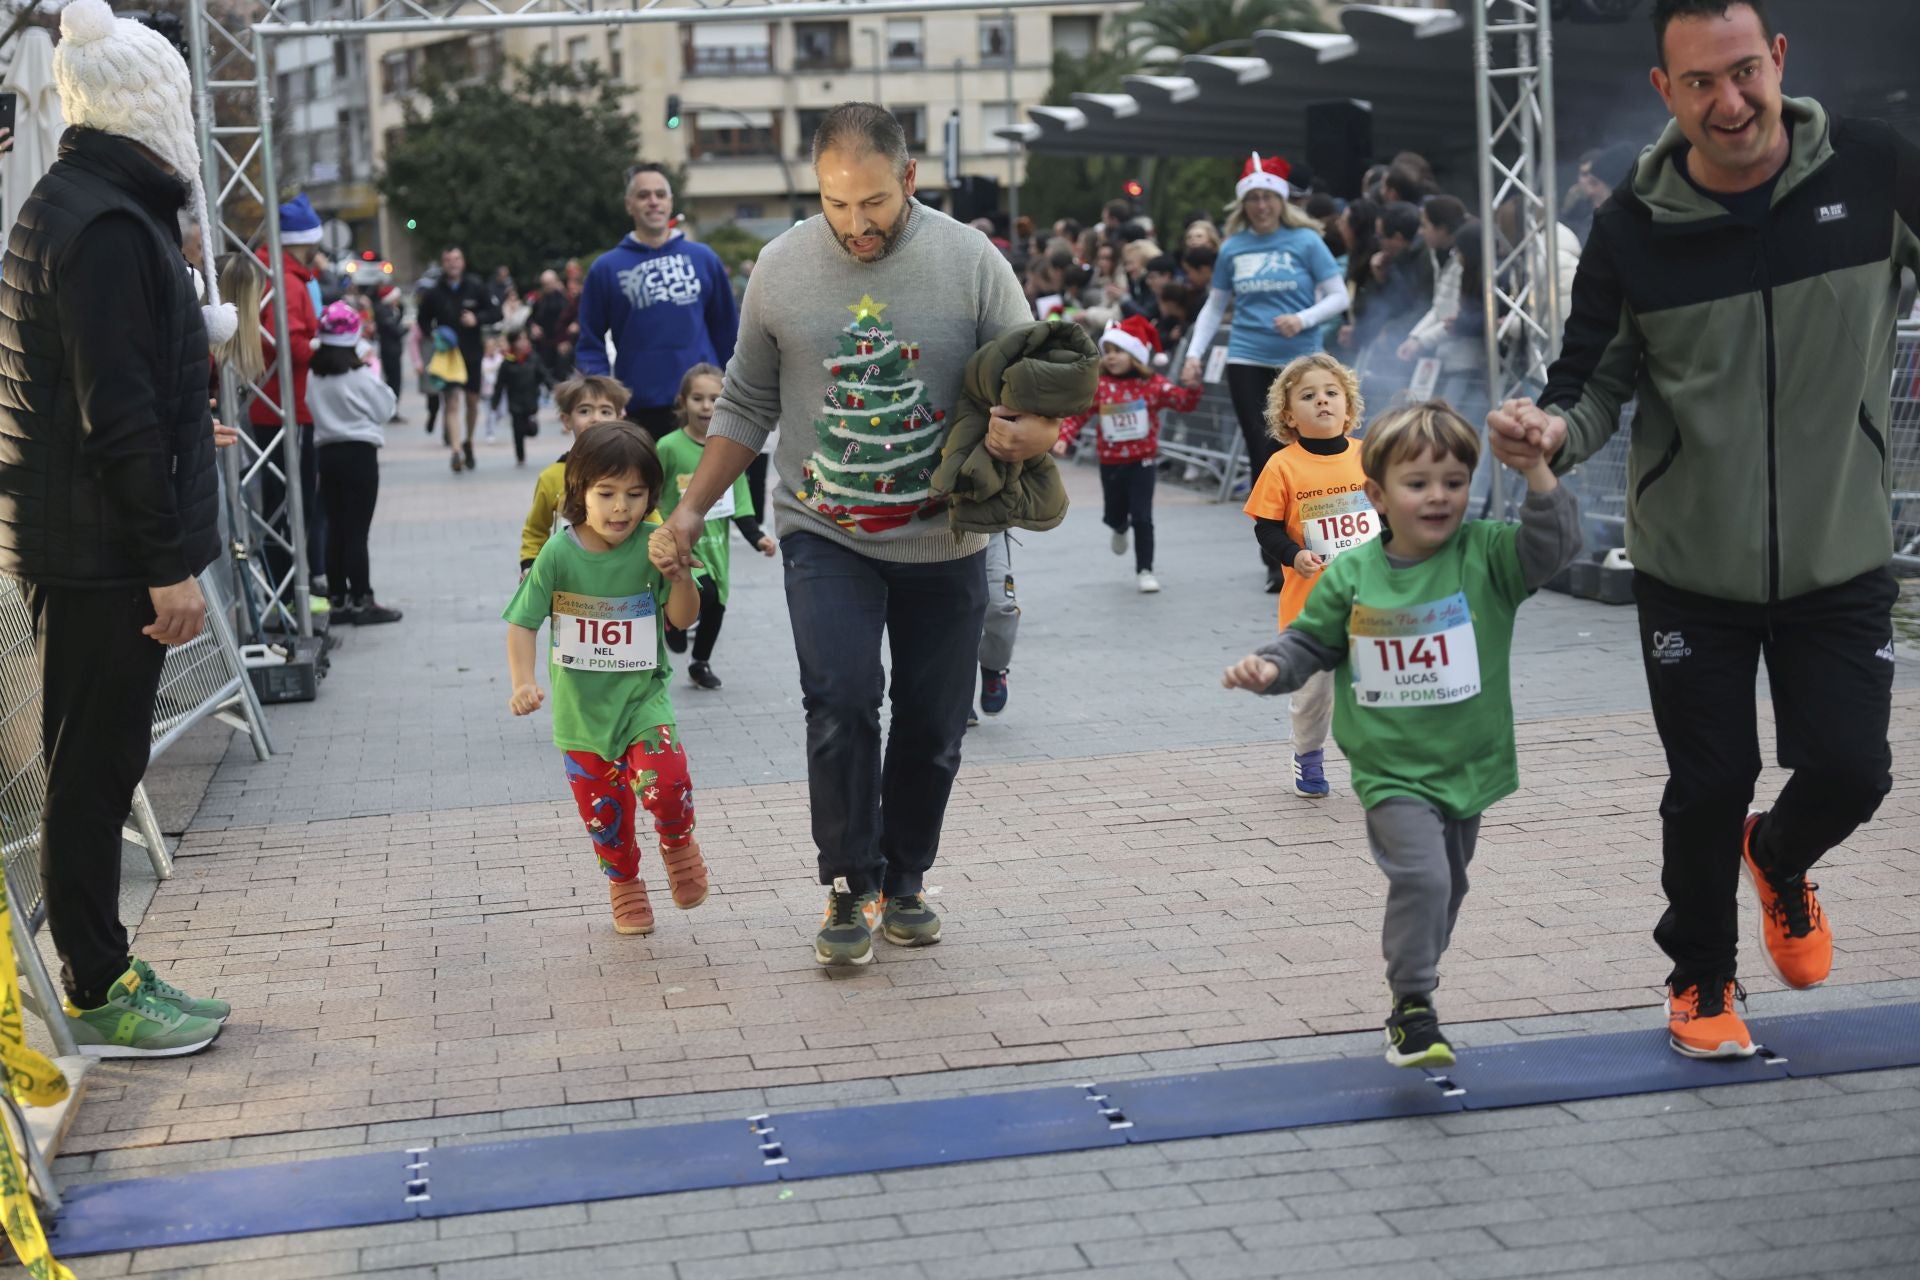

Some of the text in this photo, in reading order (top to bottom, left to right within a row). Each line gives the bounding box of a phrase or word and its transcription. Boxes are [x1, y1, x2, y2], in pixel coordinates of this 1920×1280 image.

[645, 264, 695, 288] CHU
[1296, 483, 1363, 500] Corre con Ga
[1317, 512, 1370, 540] 1186
[1335, 540, 1352, 548] LEO
[557, 595, 595, 610] Carrera
[595, 601, 614, 611] Fin
[617, 602, 628, 612] de
[636, 608, 652, 617] 2024
[576, 618, 632, 645] 1161
[594, 647, 615, 656] NEL
[1374, 634, 1449, 672] 1141
[589, 658, 647, 669] PDMSiero
[1395, 673, 1438, 685] LUCAS
[1400, 684, 1471, 701] PDMSiero
